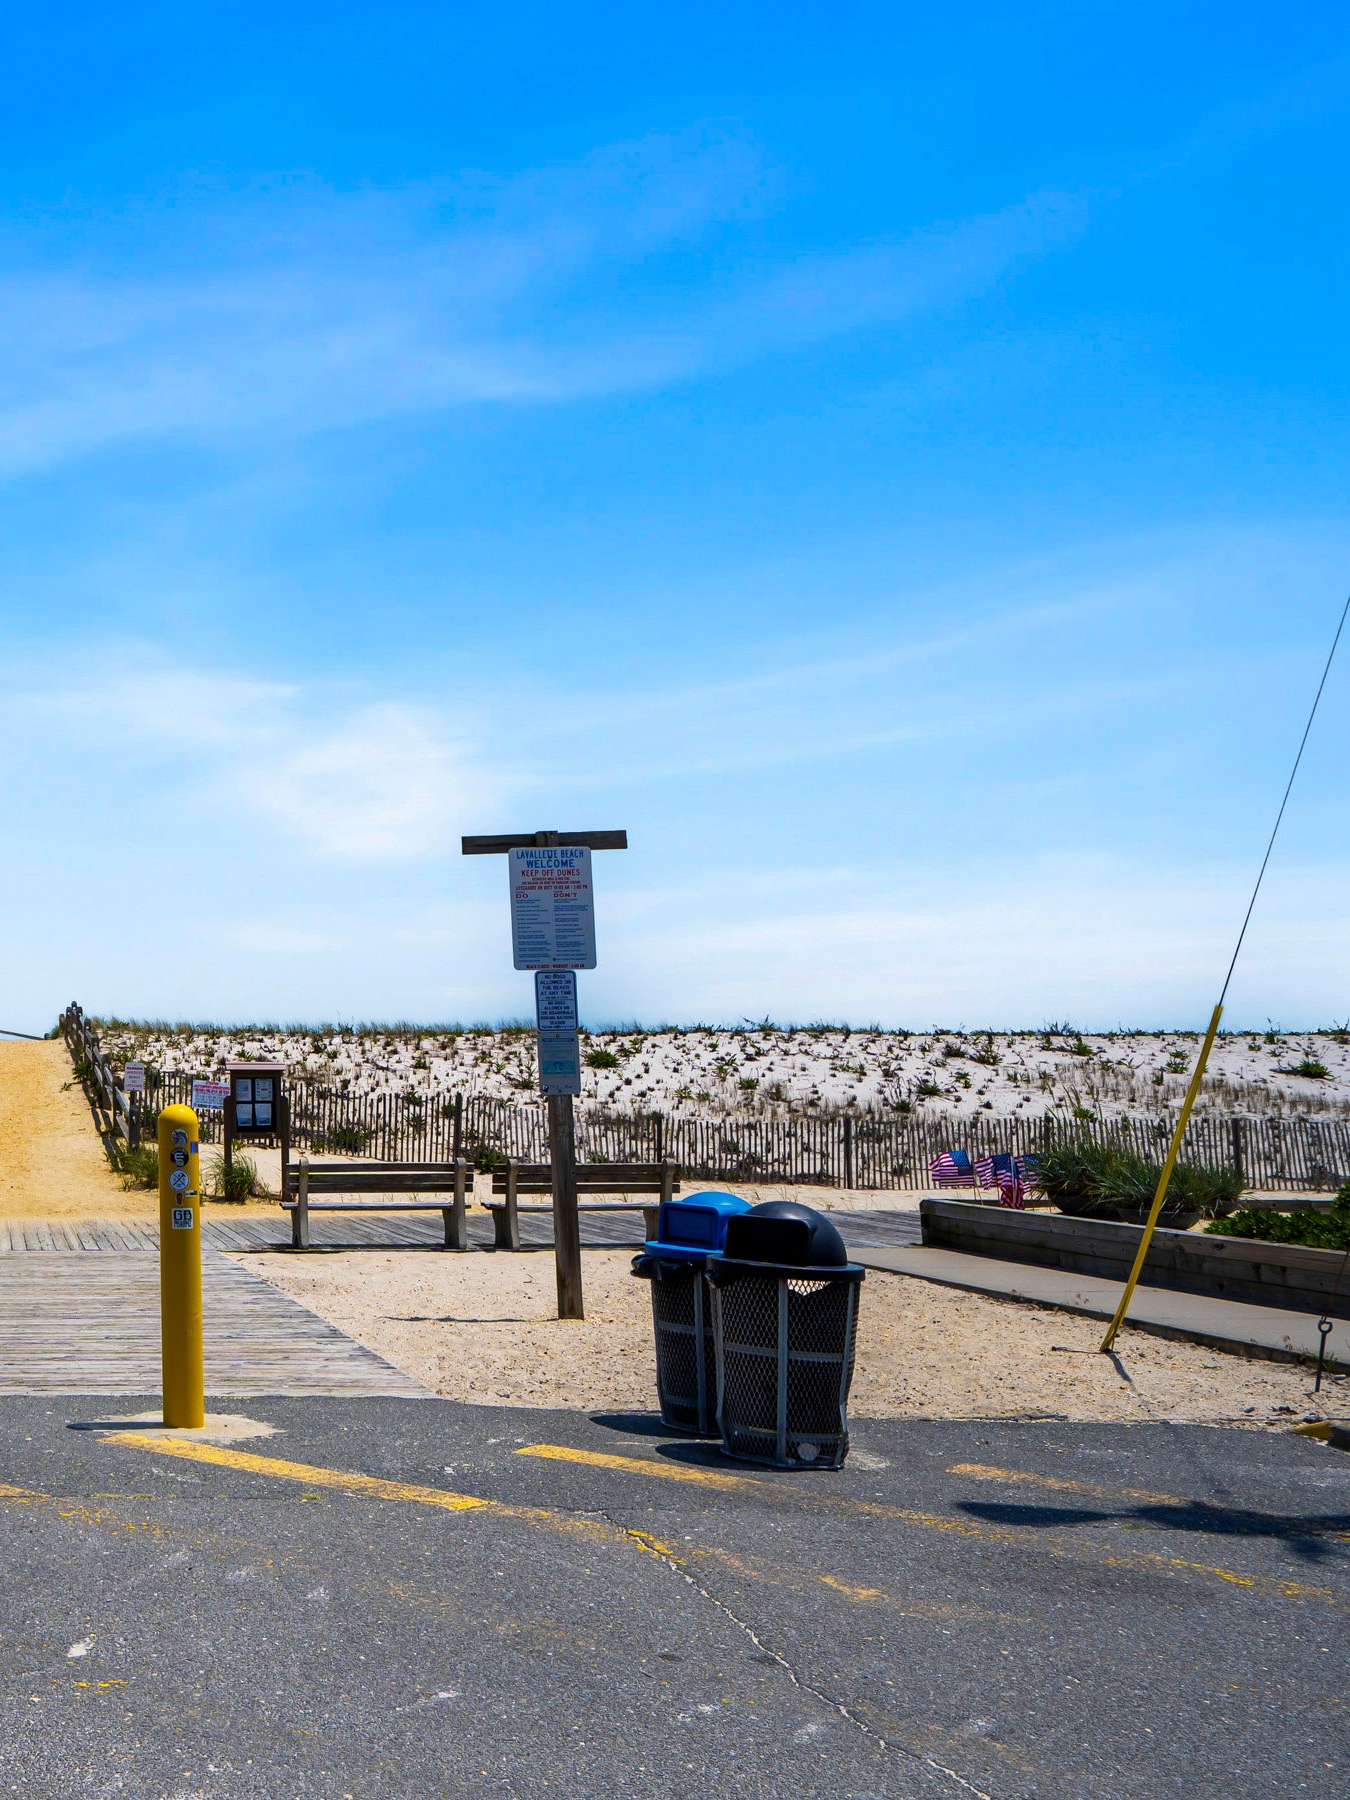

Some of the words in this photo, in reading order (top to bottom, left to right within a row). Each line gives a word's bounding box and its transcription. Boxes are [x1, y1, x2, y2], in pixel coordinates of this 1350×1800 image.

[561, 849, 584, 858] BEACH
[526, 859, 575, 868] WELCOME
[521, 869, 539, 877] KEEP
[542, 869, 554, 877] OFF
[557, 868, 580, 876] DUNES
